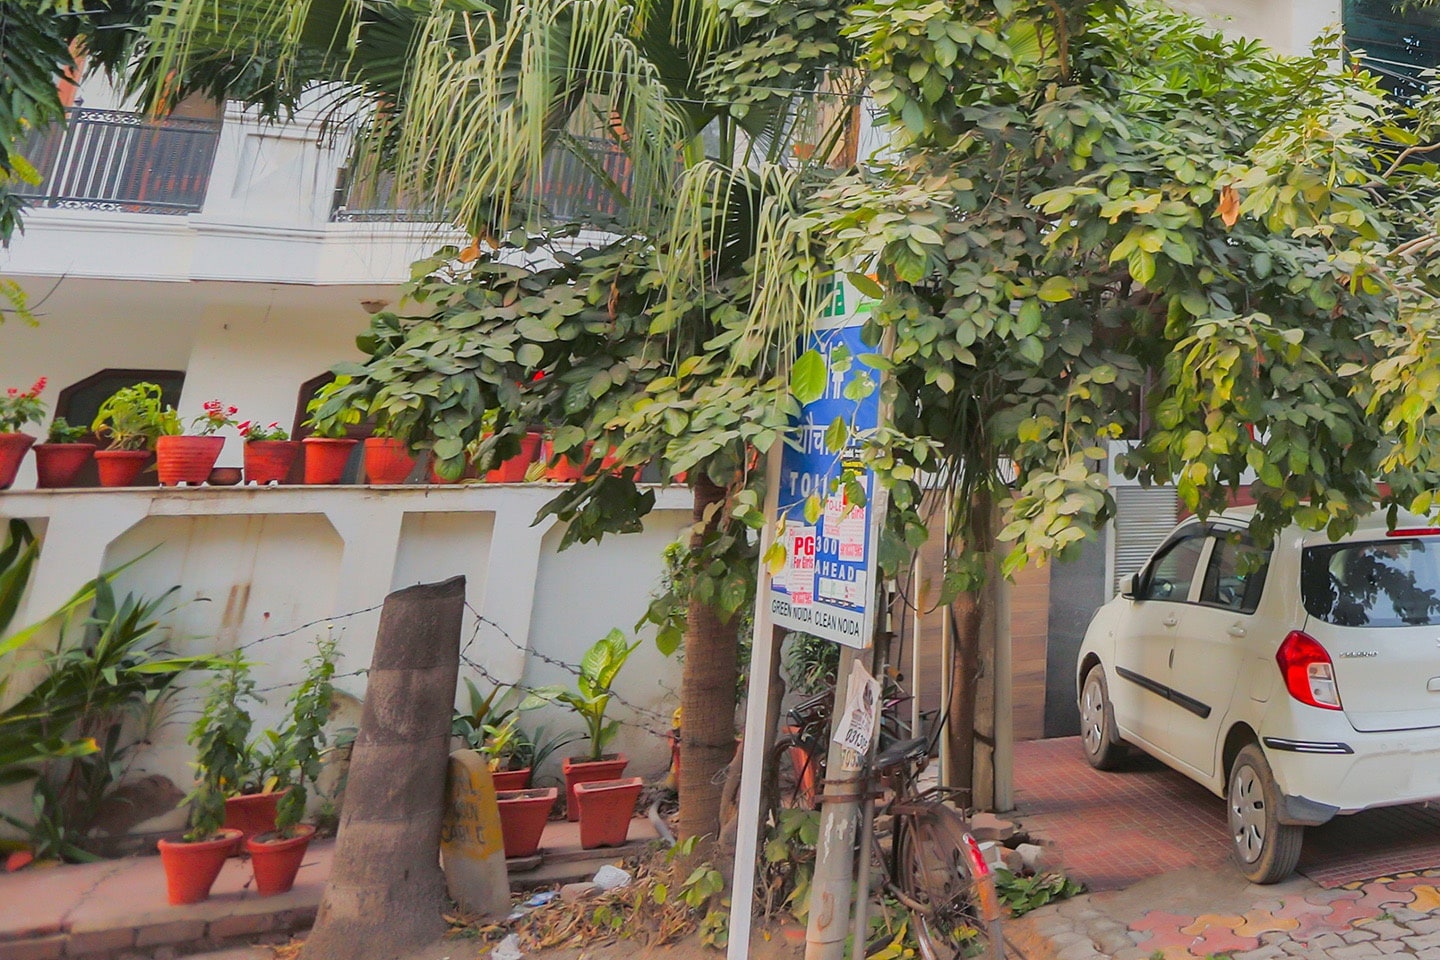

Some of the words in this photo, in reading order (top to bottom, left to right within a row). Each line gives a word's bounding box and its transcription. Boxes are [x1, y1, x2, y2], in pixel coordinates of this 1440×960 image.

[793, 536, 815, 556] PG
[815, 536, 837, 555] 300
[815, 560, 855, 581] AHEAD
[771, 599, 792, 618] GREEN
[793, 607, 812, 624] NOIDA
[815, 611, 837, 631] CLEAN
[838, 618, 860, 637] NOIDA
